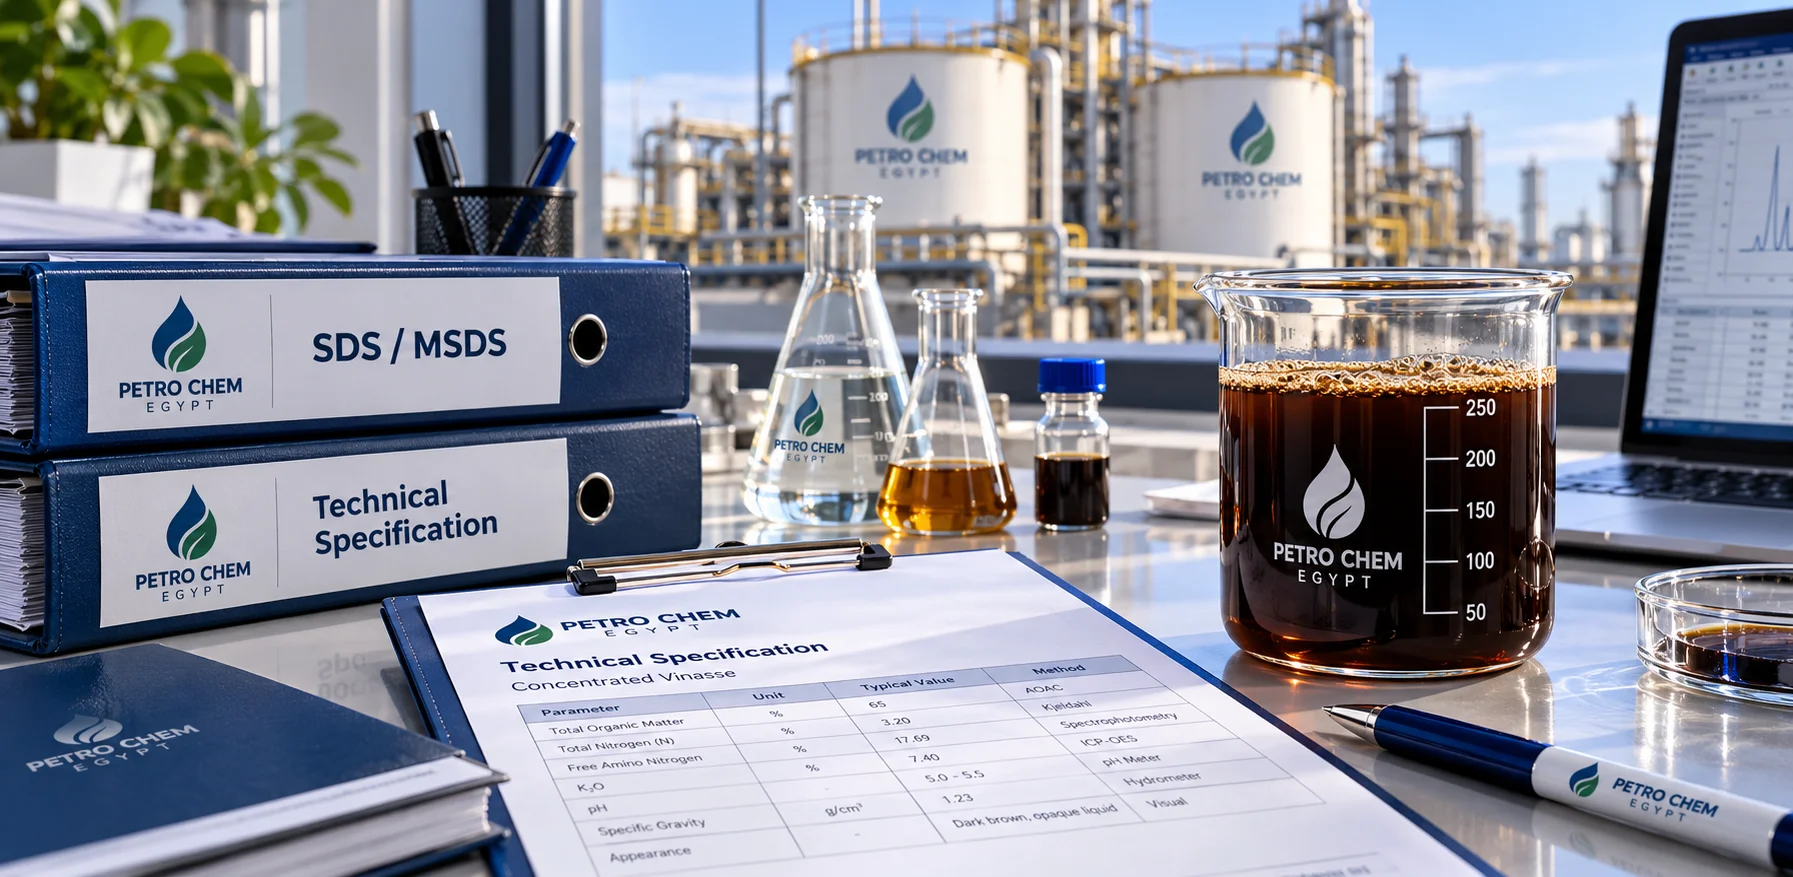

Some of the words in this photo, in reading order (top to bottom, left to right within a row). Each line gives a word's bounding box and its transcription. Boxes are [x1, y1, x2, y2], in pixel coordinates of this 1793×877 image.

[855, 148, 913, 164] PETRO
[917, 148, 966, 164] CHEM
[880, 167, 939, 179] EGYPT
[1202, 172, 1254, 186] PETRO
[1258, 172, 1300, 187] CHEM
[1224, 190, 1280, 199] EGYPT
[313, 332, 381, 362] SDS
[390, 328, 404, 364] /
[415, 329, 506, 359] MSDS
[120, 380, 182, 398] PETRO
[188, 378, 242, 395] CHEM
[147, 400, 213, 412] EGYPT
[1466, 398, 1495, 416] 250
[774, 440, 808, 451] PETRO
[811, 442, 844, 454] CHEM
[787, 453, 825, 463] EGYPT
[1466, 449, 1495, 467] 200
[313, 480, 447, 519] Technical
[1467, 501, 1494, 519] 150
[316, 513, 497, 559] Specification
[1274, 542, 1334, 566] PETRO
[1341, 550, 1402, 570] CHEM
[1467, 552, 1494, 569] 100
[136, 568, 195, 590] PETRO
[201, 561, 250, 581] CHEM
[1299, 570, 1371, 588] EGYPT
[163, 584, 224, 602] EGYPT
[561, 616, 649, 630] PETRO
[658, 609, 740, 623] CHEM
[1466, 603, 1486, 621] 50
[605, 624, 701, 636] EGYPT
[500, 654, 642, 672] Technical
[650, 642, 829, 666] Specification
[1032, 665, 1086, 674] Method
[512, 674, 654, 691] Concentrated
[658, 671, 736, 681] Vinasse
[860, 680, 912, 691] Typical
[753, 692, 784, 700] Unit
[1026, 685, 1063, 693] AOAC
[542, 706, 619, 716] Parameter
[1042, 700, 1092, 711] Kjeldahl
[549, 726, 583, 735] Total
[587, 722, 638, 732] Organic
[1060, 713, 1177, 729] Spectrophotometry
[558, 744, 592, 752] Total
[595, 741, 651, 749] Nitrogen
[655, 738, 674, 746] (N)
[895, 735, 930, 743] 17.69
[1080, 735, 1137, 746] ICP-OES
[26, 745, 114, 772] PETRO
[120, 725, 199, 749] CHEM
[73, 743, 169, 771] EGYPT
[602, 760, 643, 769] Amino
[646, 756, 702, 765] Nitrogen
[909, 754, 939, 762] 7.40
[1103, 758, 1122, 768] pH
[1123, 755, 1160, 763] Meter
[925, 774, 948, 782] 5.0
[962, 770, 984, 778] 5.5
[1124, 772, 1201, 787] Hydrometer
[943, 794, 973, 803] 1.23
[1146, 797, 1188, 808] Visual
[1613, 778, 1665, 801] PETRO
[1669, 794, 1719, 818] CHEM
[588, 804, 607, 815] pH
[825, 803, 862, 816] g/cm³
[952, 818, 984, 828] Dark
[986, 813, 1031, 825] brown,
[1033, 810, 1080, 823] opaque
[1082, 804, 1118, 816] liquid
[1630, 799, 1686, 822] EGYPT
[598, 824, 653, 837] Specific
[656, 820, 704, 829] Gravity
[611, 848, 691, 863] Appearance
